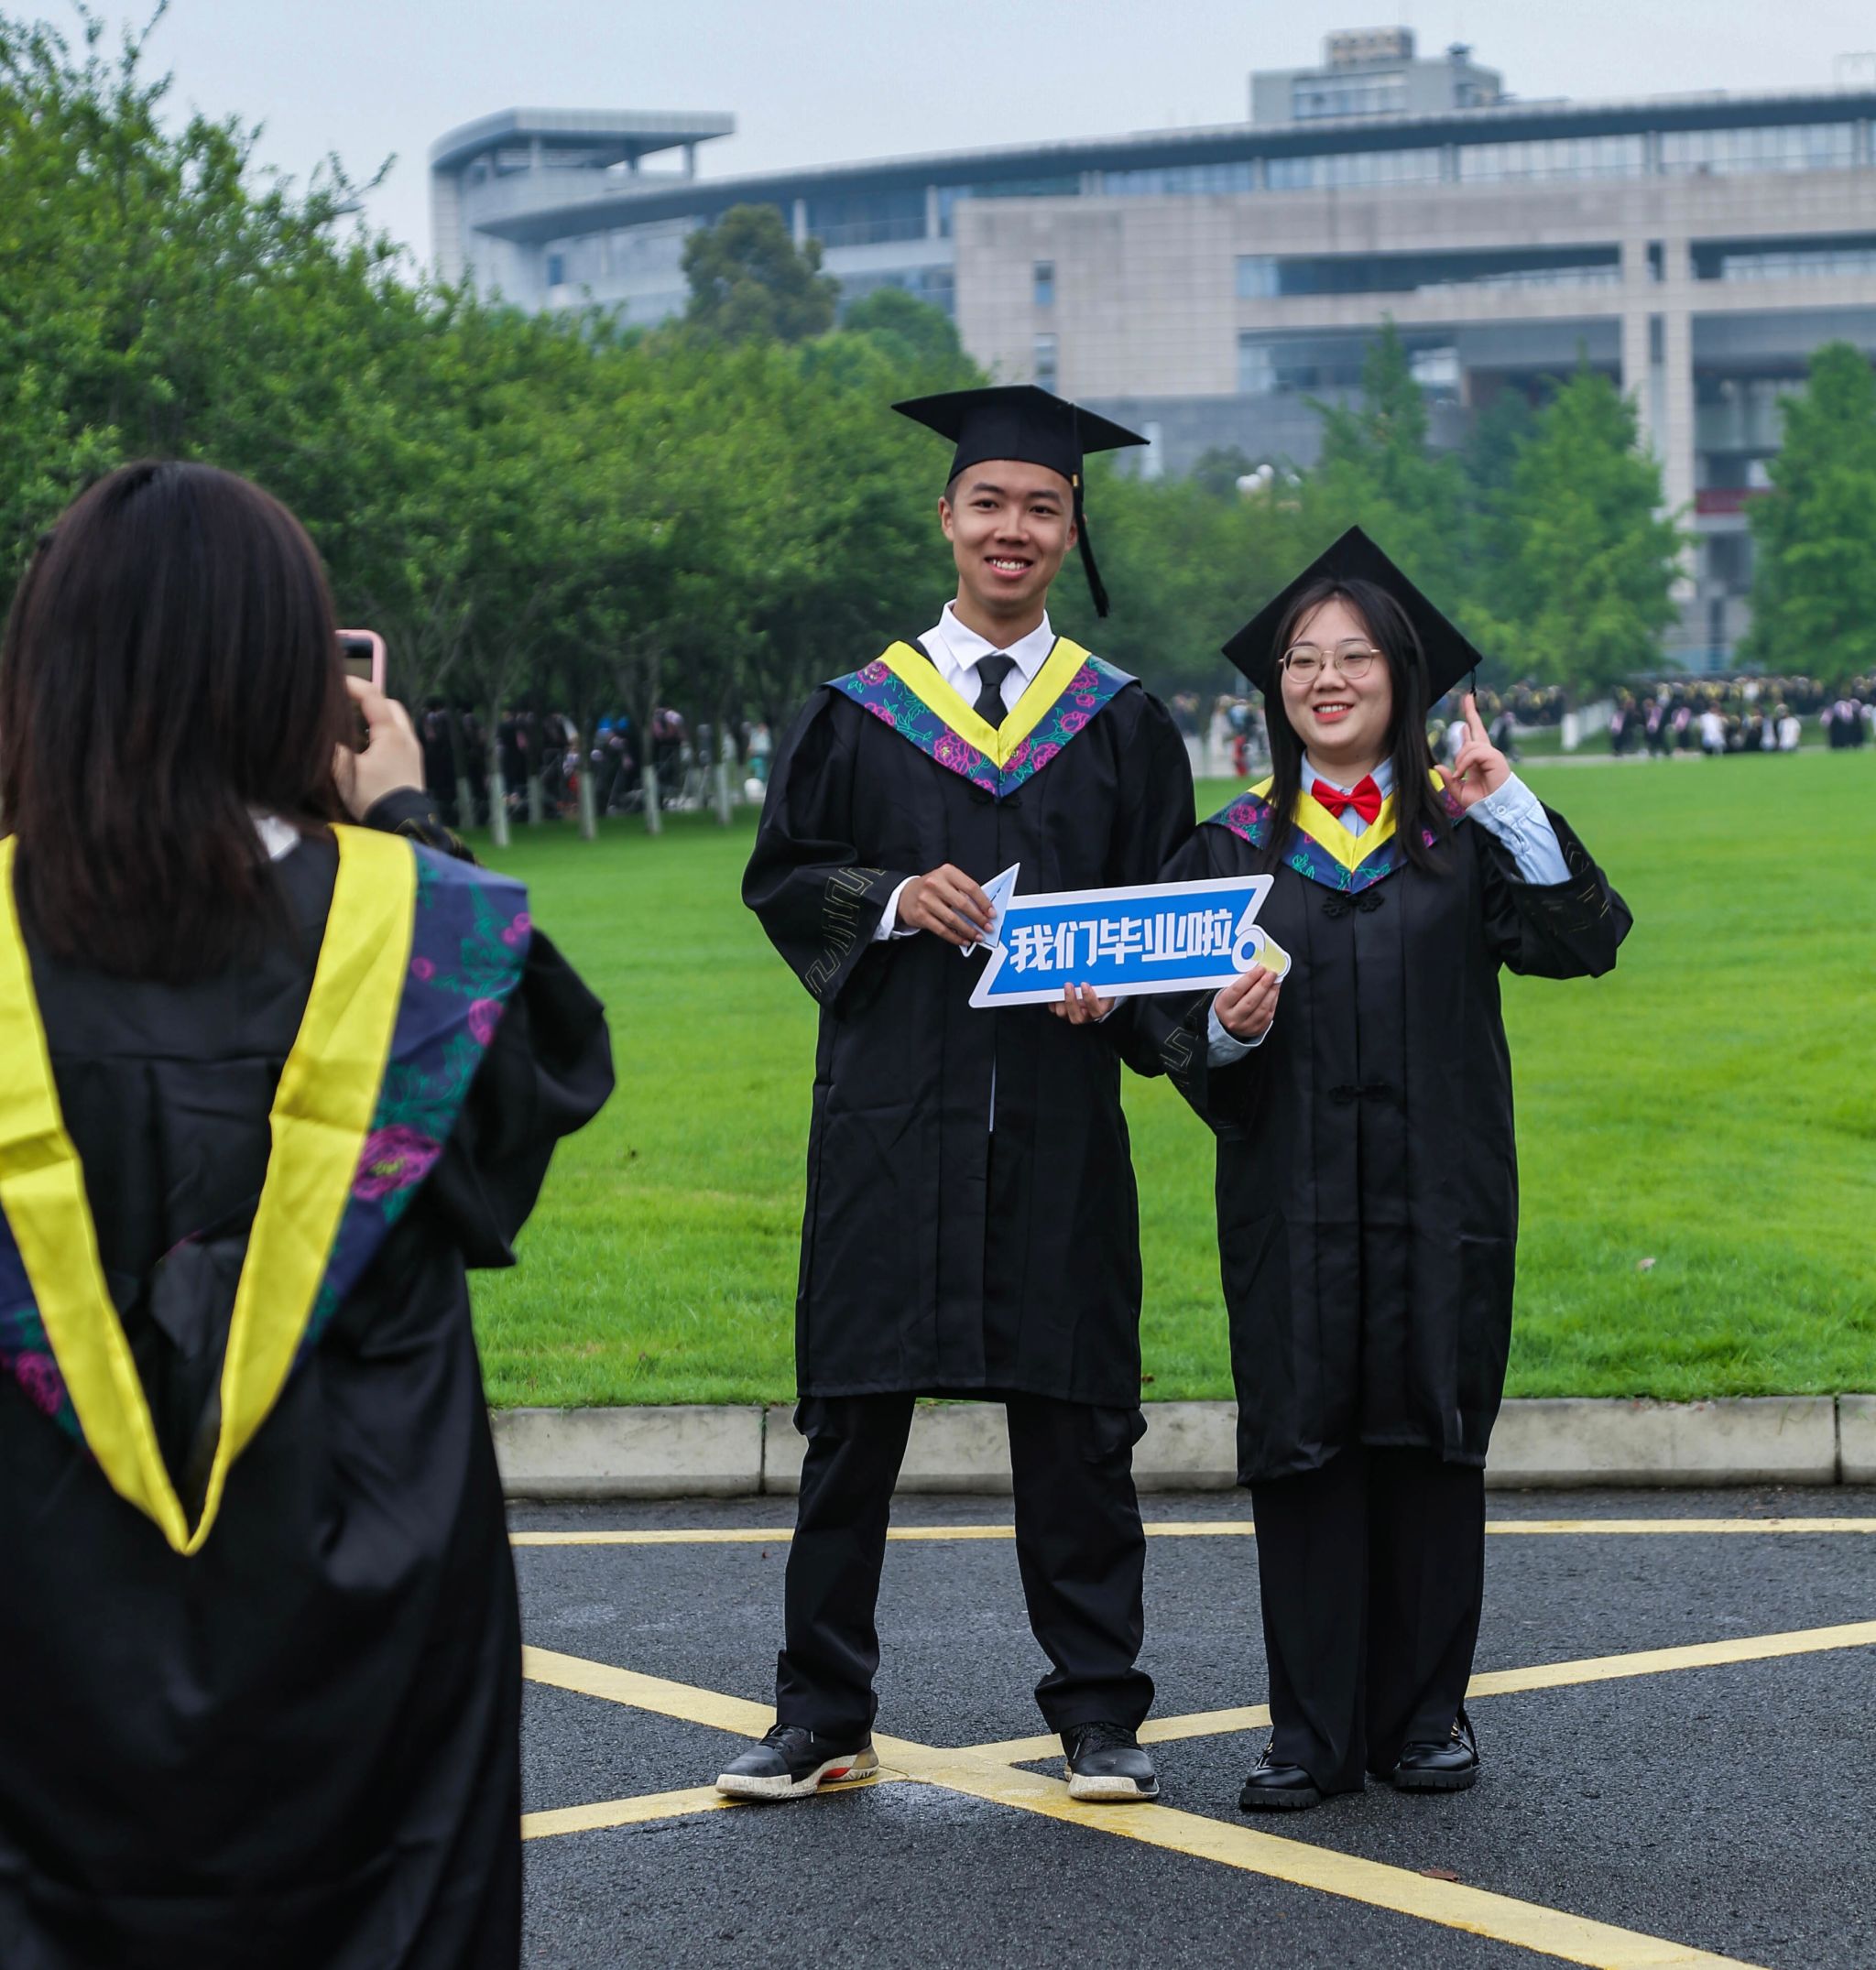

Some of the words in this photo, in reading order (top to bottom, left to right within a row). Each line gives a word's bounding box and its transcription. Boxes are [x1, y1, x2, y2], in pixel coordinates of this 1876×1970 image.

[1009, 909, 1232, 973] 我们毕业啦
